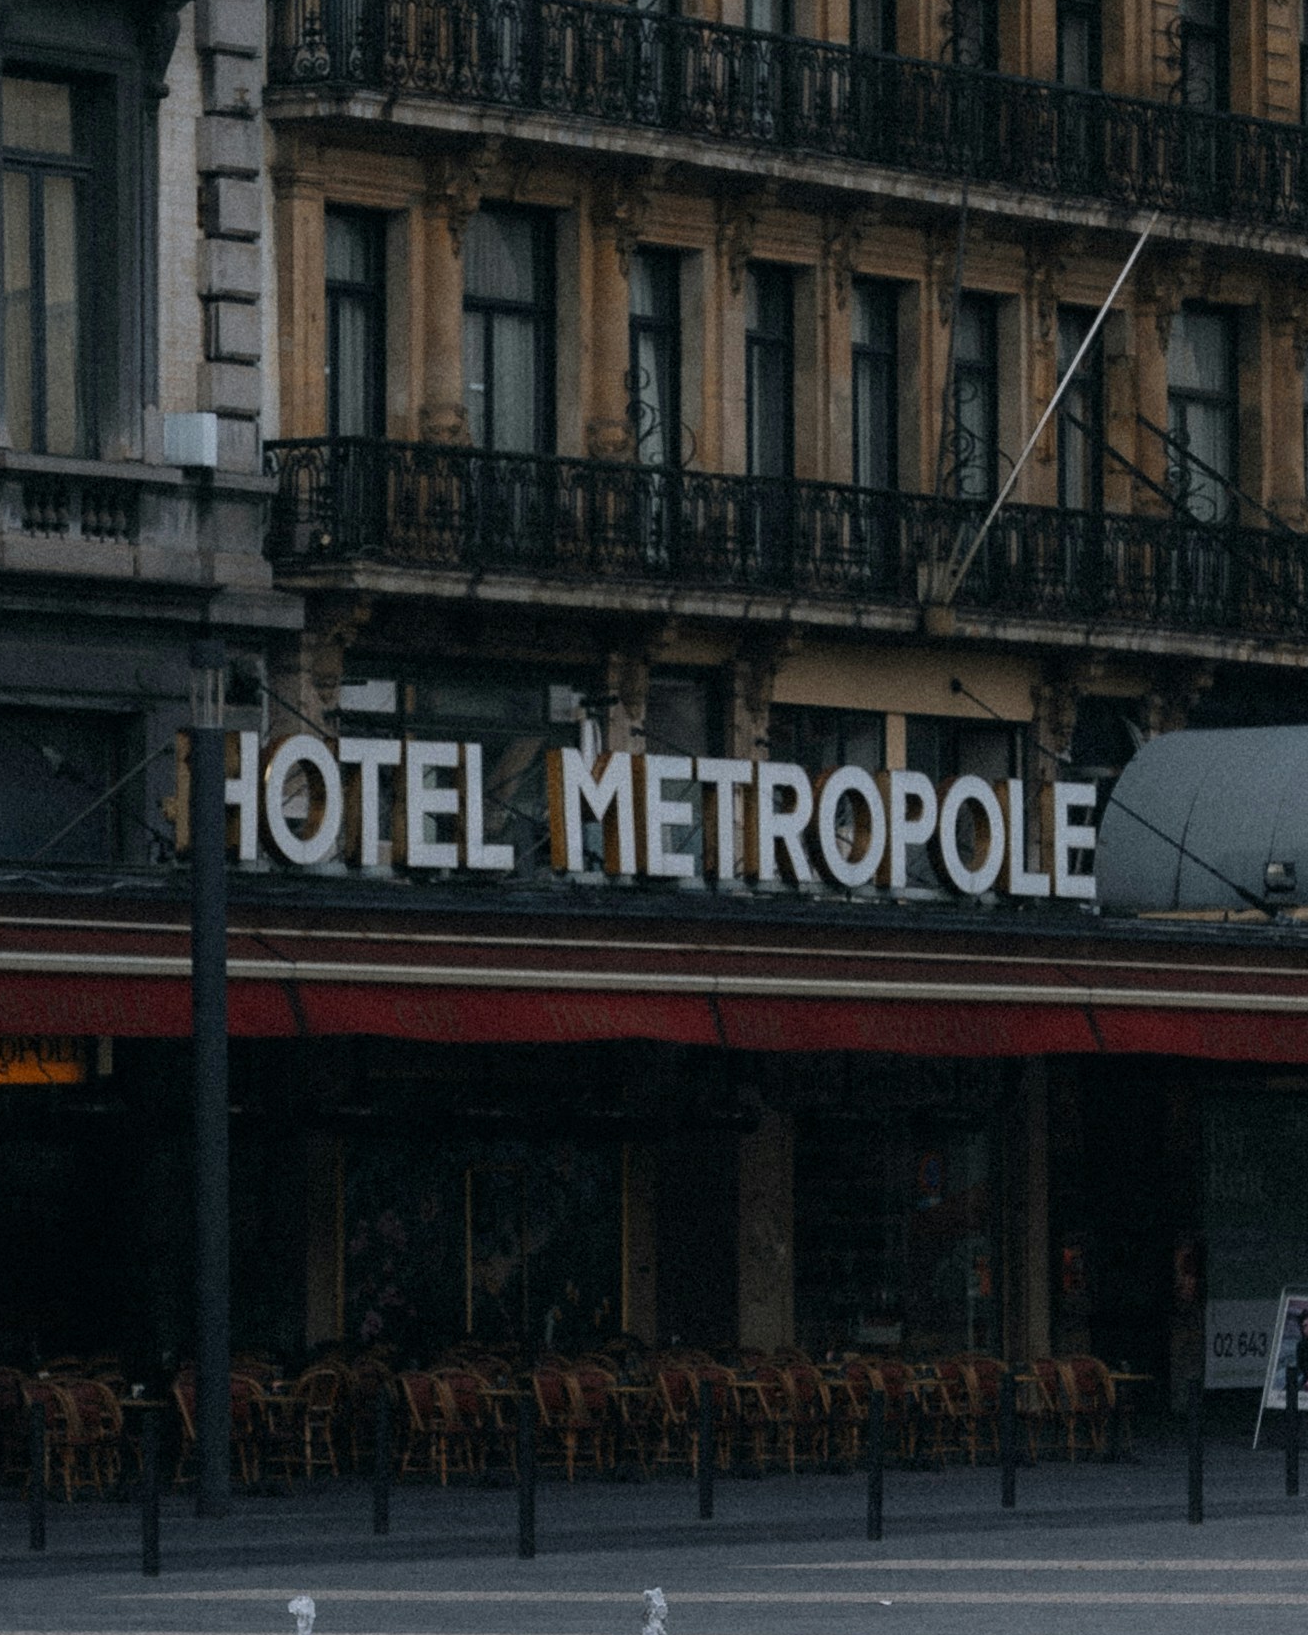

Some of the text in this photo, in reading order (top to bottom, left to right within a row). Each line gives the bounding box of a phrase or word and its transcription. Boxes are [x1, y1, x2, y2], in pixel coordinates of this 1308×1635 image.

[225, 730, 1096, 900] HOTEL METROPOLE
[1213, 1330, 1268, 1358] 02 643
